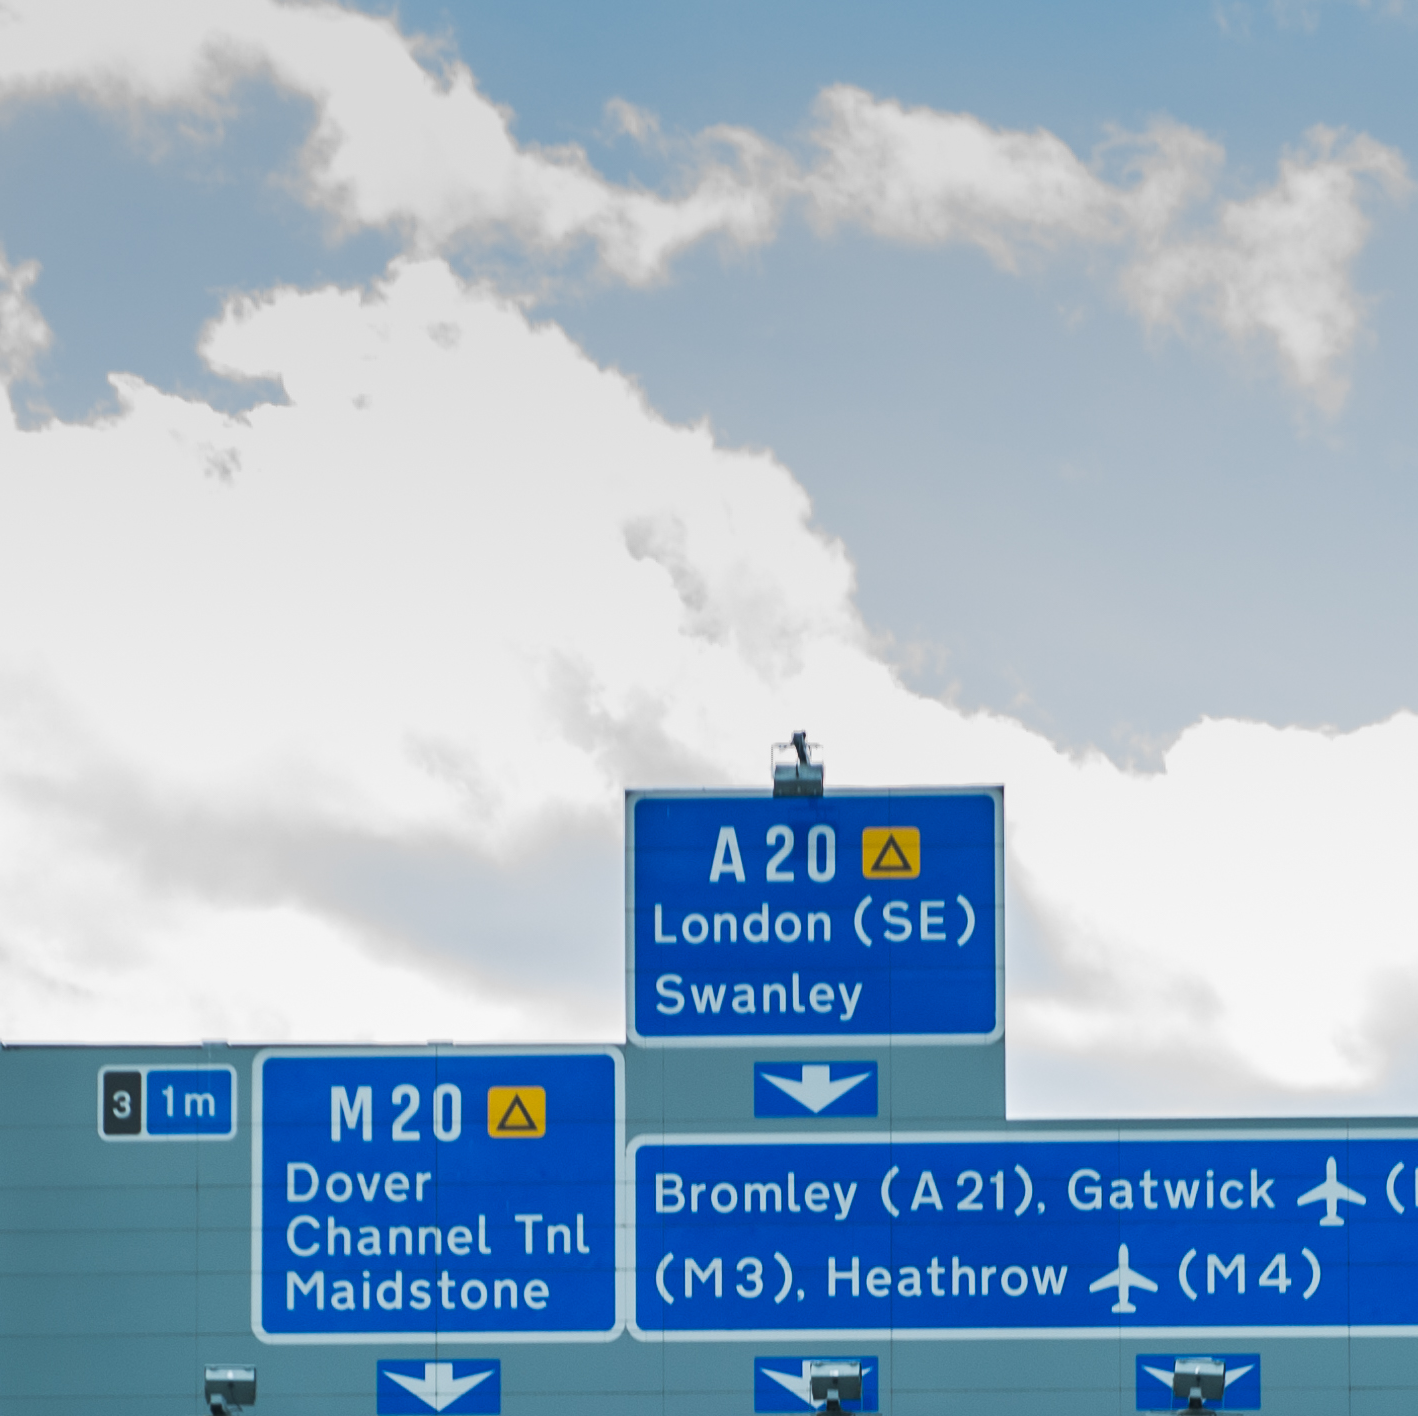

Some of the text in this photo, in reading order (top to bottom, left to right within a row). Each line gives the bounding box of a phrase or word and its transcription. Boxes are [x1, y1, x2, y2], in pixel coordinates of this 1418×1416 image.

[654, 894, 976, 947] London (SE)
[655, 972, 863, 1021] Swanley
[112, 1090, 131, 1119] 3
[162, 1085, 216, 1118] 1m
[286, 1162, 433, 1203] Dover
[654, 1172, 858, 1221] Bromley
[1067, 1168, 1276, 1211] Gatwick
[286, 1213, 590, 1257] Channel Tnl
[286, 1270, 551, 1311] Maidstone
[827, 1256, 1069, 1298] Heathrow
